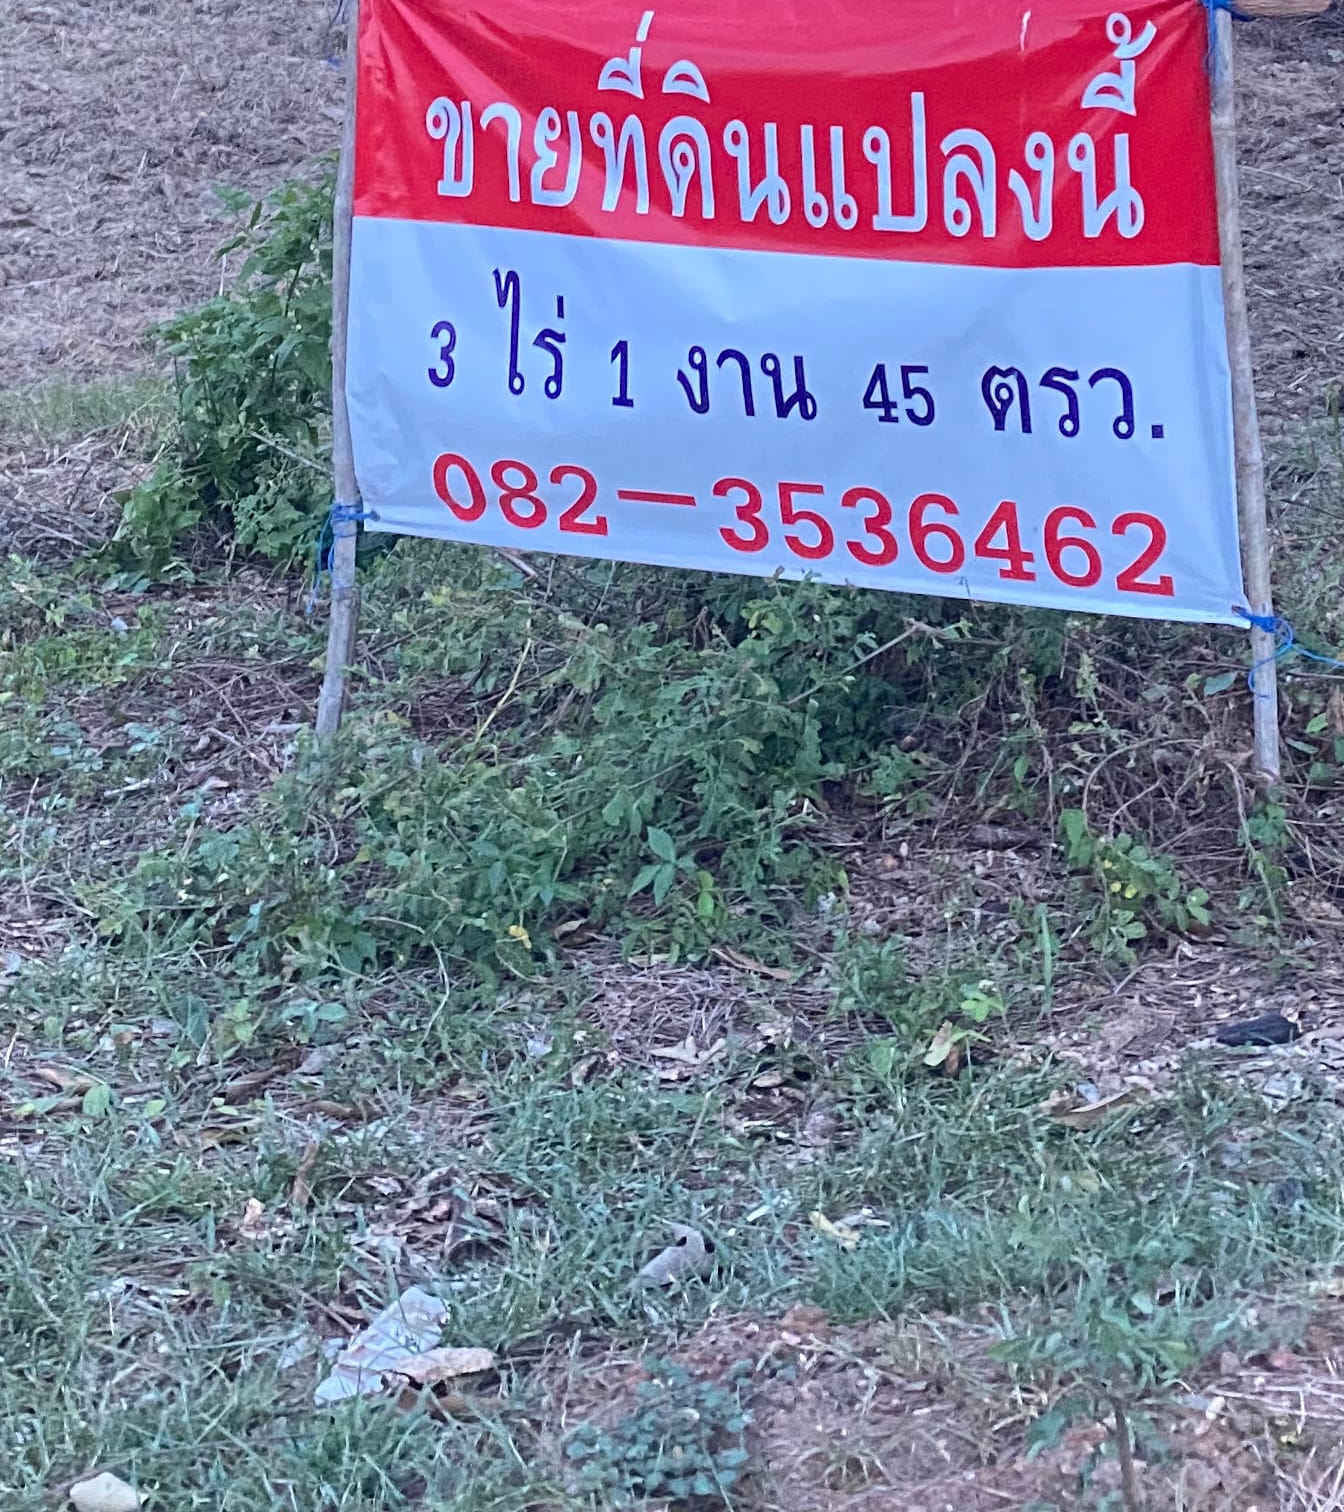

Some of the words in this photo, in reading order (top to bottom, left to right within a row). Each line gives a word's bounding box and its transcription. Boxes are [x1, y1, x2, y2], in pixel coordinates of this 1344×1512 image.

[425, 10, 1158, 242] ขายที่ดินแปลงนี้
[428, 320, 457, 389] 3
[494, 268, 568, 401] ไร่
[610, 340, 635, 408] 1
[676, 344, 818, 423] งาน
[862, 363, 936, 427] 45
[981, 365, 1166, 440] ตรว.
